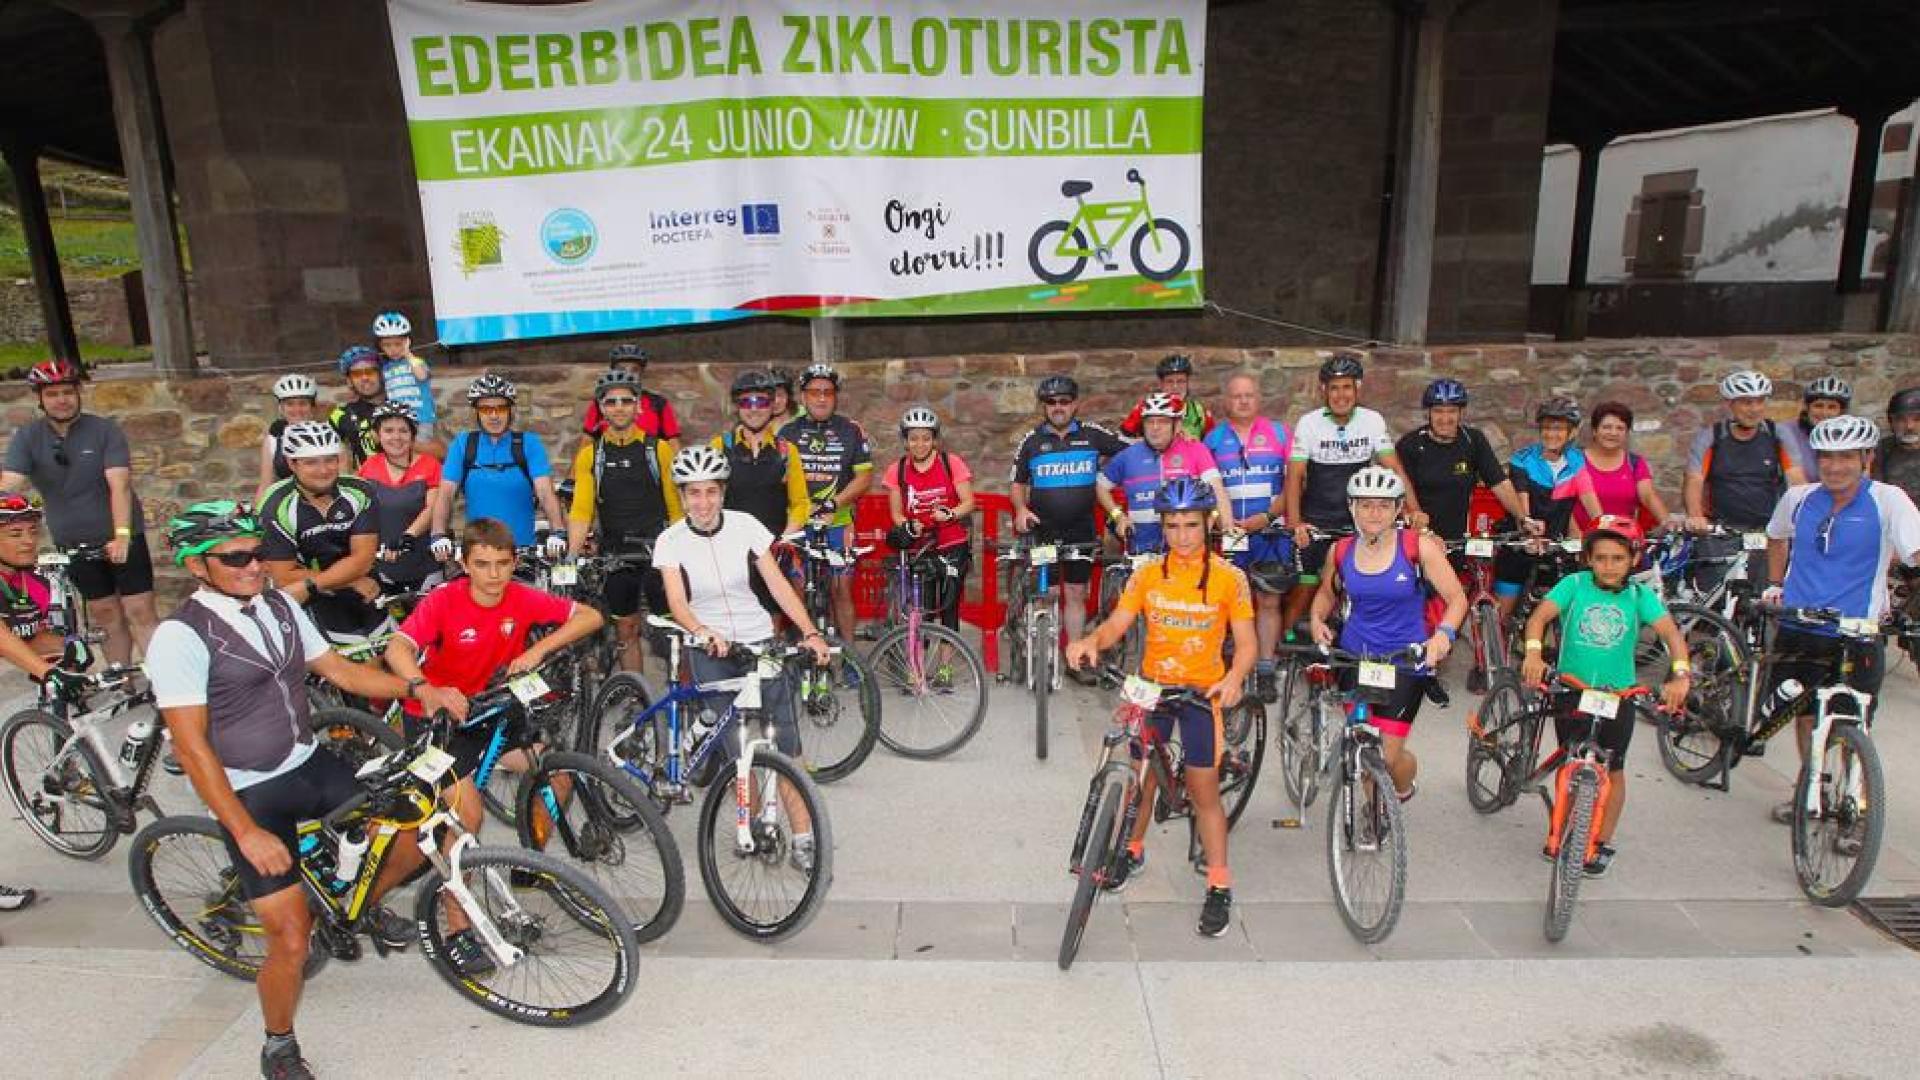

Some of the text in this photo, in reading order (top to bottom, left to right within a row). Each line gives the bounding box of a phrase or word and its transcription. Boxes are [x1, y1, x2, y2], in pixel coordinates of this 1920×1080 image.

[411, 15, 1192, 97] EDERBIDEA ZIKLOTURISTA
[450, 106, 1152, 174] EKAINAK 24 JUNIO JUIN SUNBILLA
[649, 208, 737, 229] Interreg
[884, 199, 950, 240] Ongi
[652, 228, 713, 244] POCTEFA
[1037, 460, 1093, 477] ETXALAR
